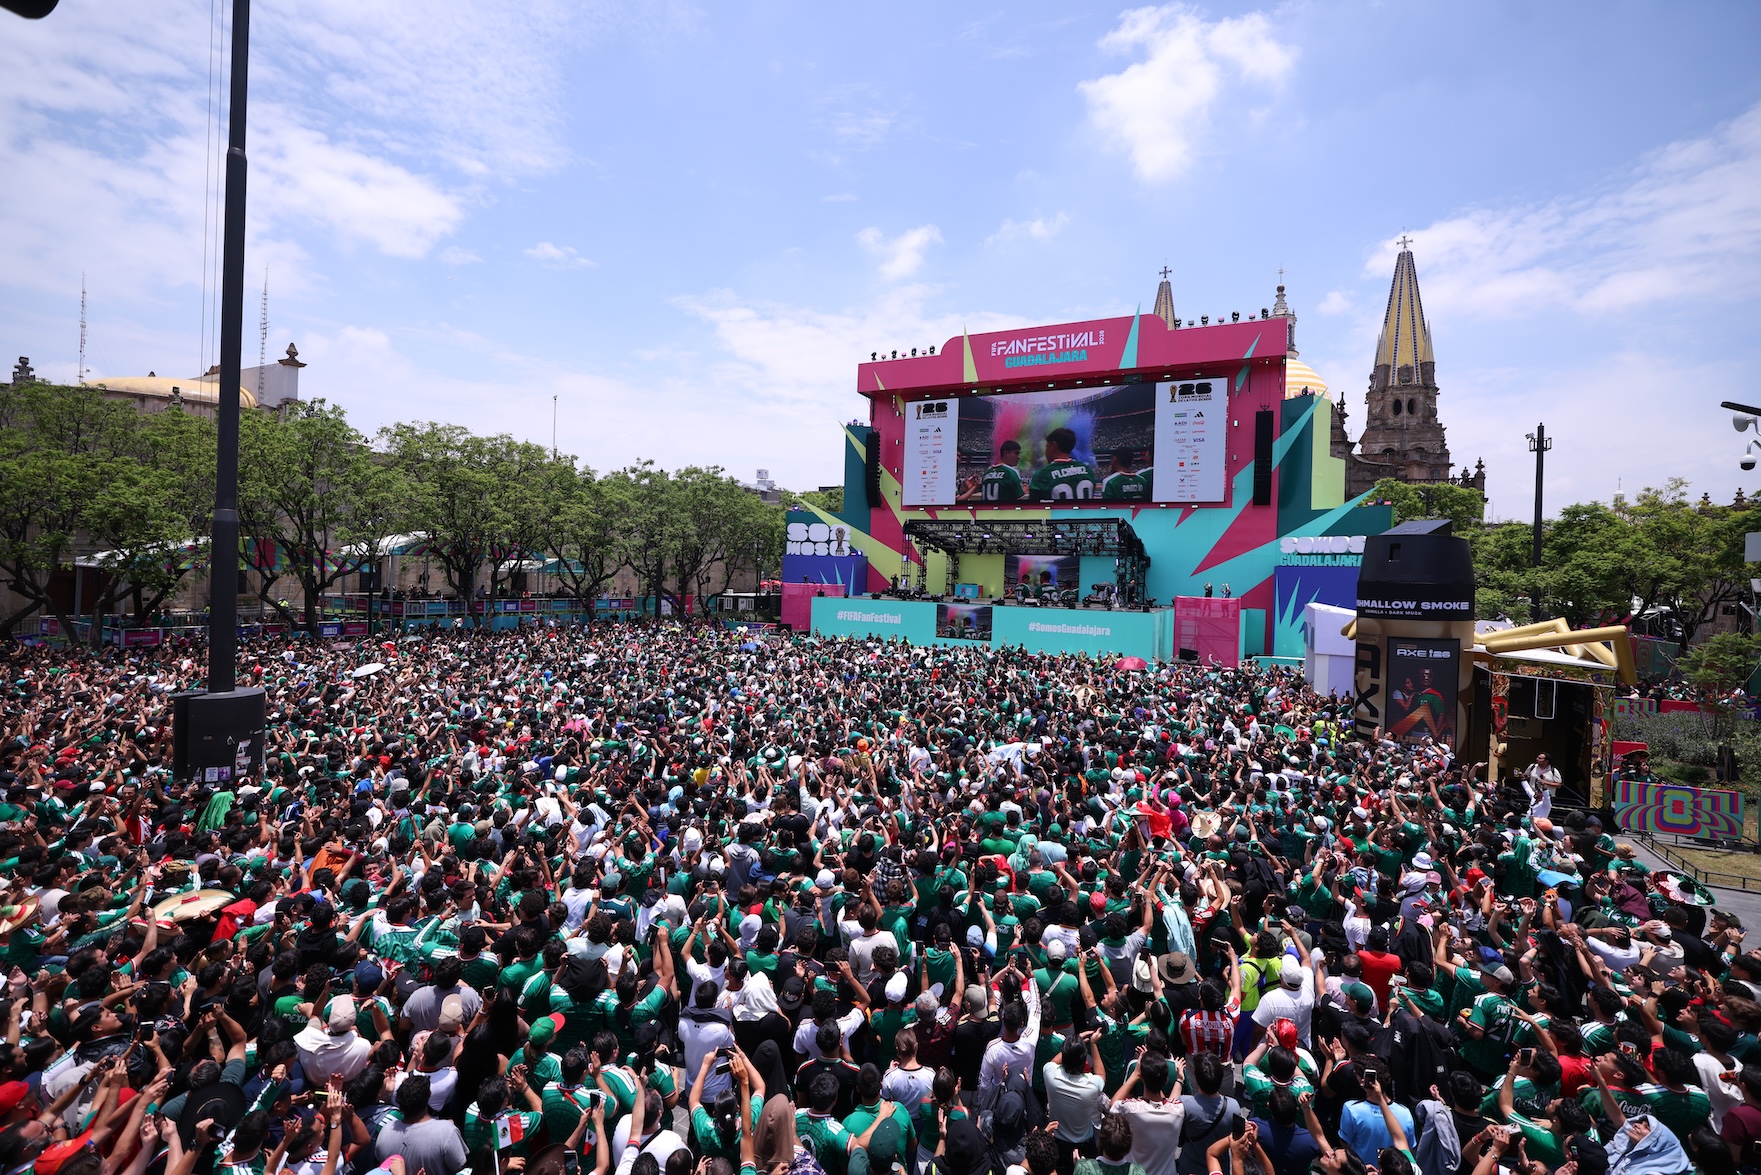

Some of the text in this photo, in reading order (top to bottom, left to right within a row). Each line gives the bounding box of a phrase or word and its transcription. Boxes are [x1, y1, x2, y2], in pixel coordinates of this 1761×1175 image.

[1005, 349, 1088, 368] GUADALAJARA
[1178, 382, 1213, 395] 26
[922, 402, 948, 414] 26
[1280, 535, 1367, 554] SOMOS
[1420, 601, 1470, 610] SMOKE
[837, 610, 902, 625] #FIFAFanFestival
[1028, 622, 1111, 637] #SomosGuadalajara
[1396, 649, 1427, 658] AXE
